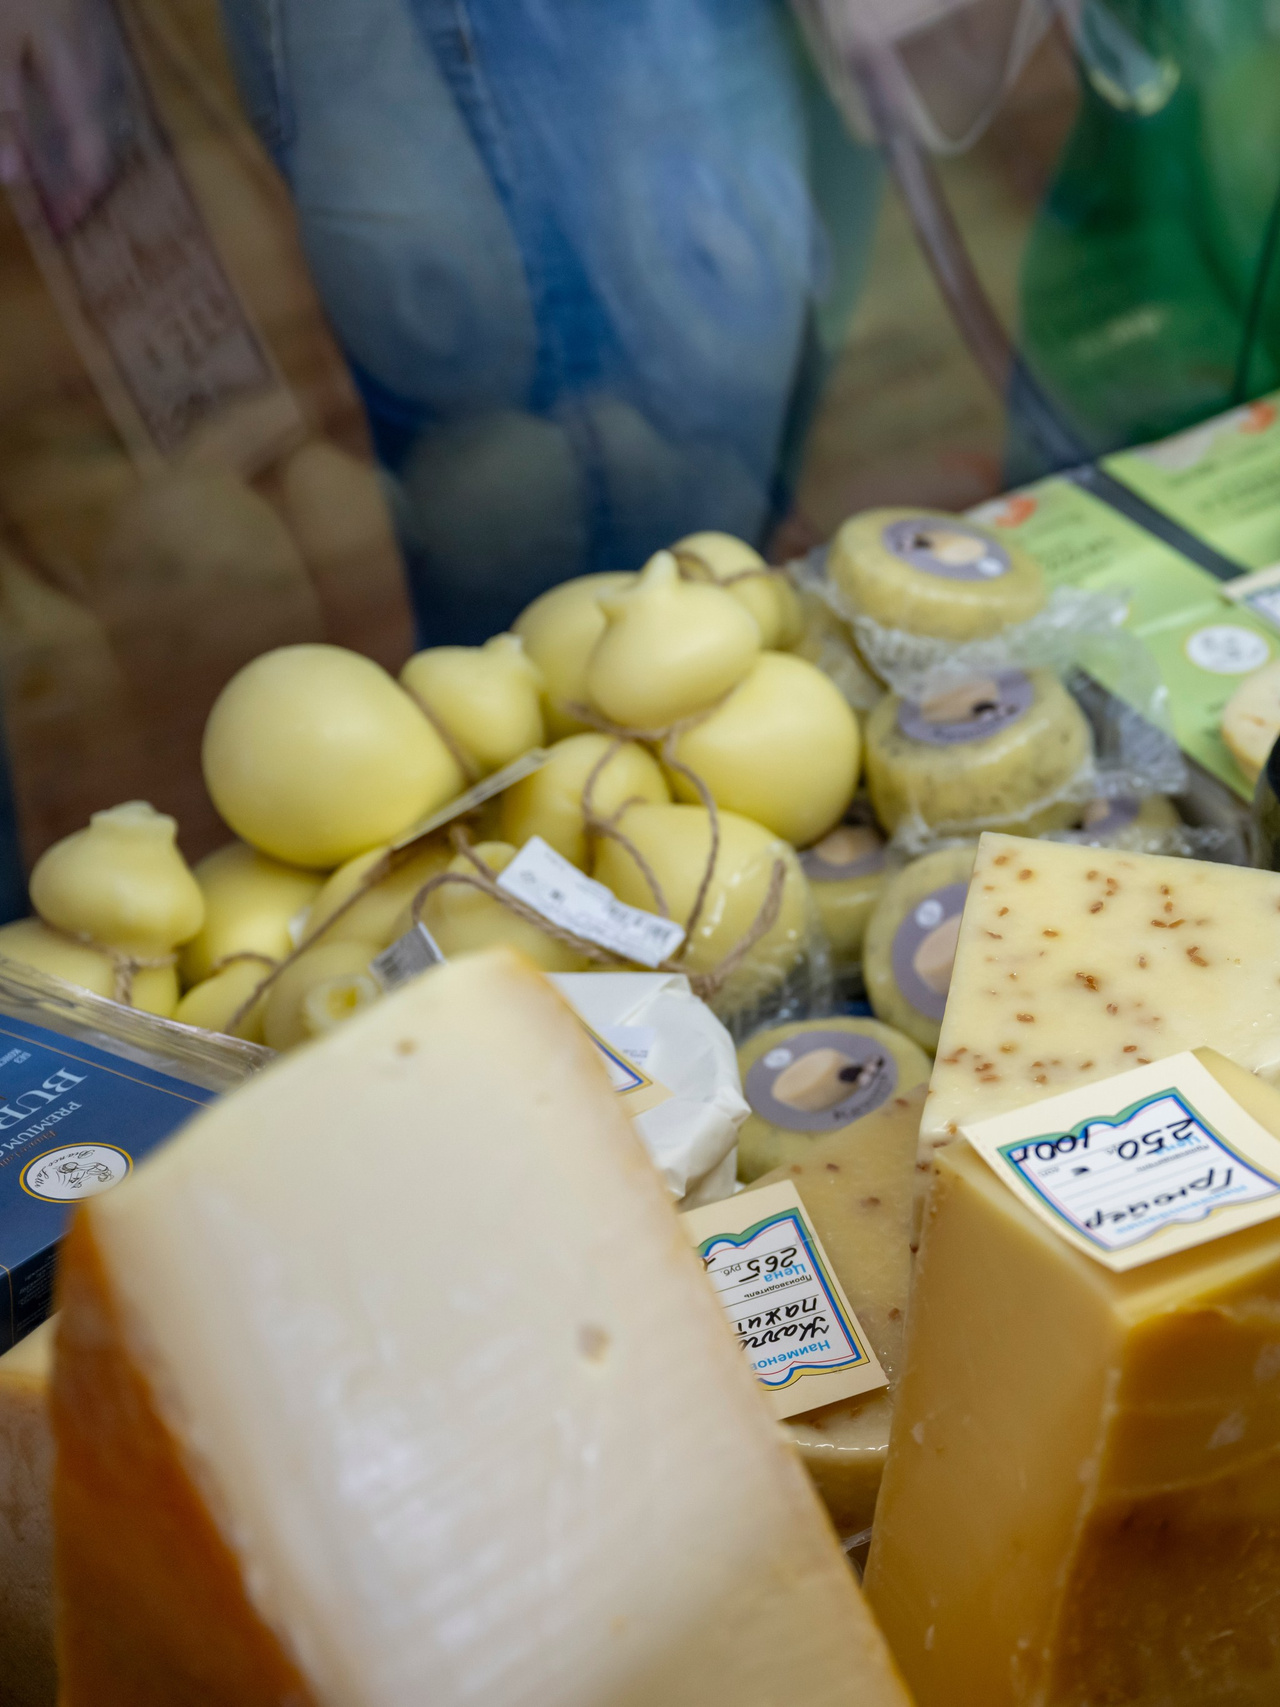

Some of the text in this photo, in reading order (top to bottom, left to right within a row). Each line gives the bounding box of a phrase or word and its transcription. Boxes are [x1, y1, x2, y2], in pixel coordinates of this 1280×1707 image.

[1, 1101, 83, 1150] PREMIUM
[1117, 1118, 1195, 1160] 250
[720, 1263, 742, 1277] руб.
[739, 1247, 798, 1283] 265
[764, 1263, 807, 1283] Цена
[743, 1274, 814, 1299] Производитель
